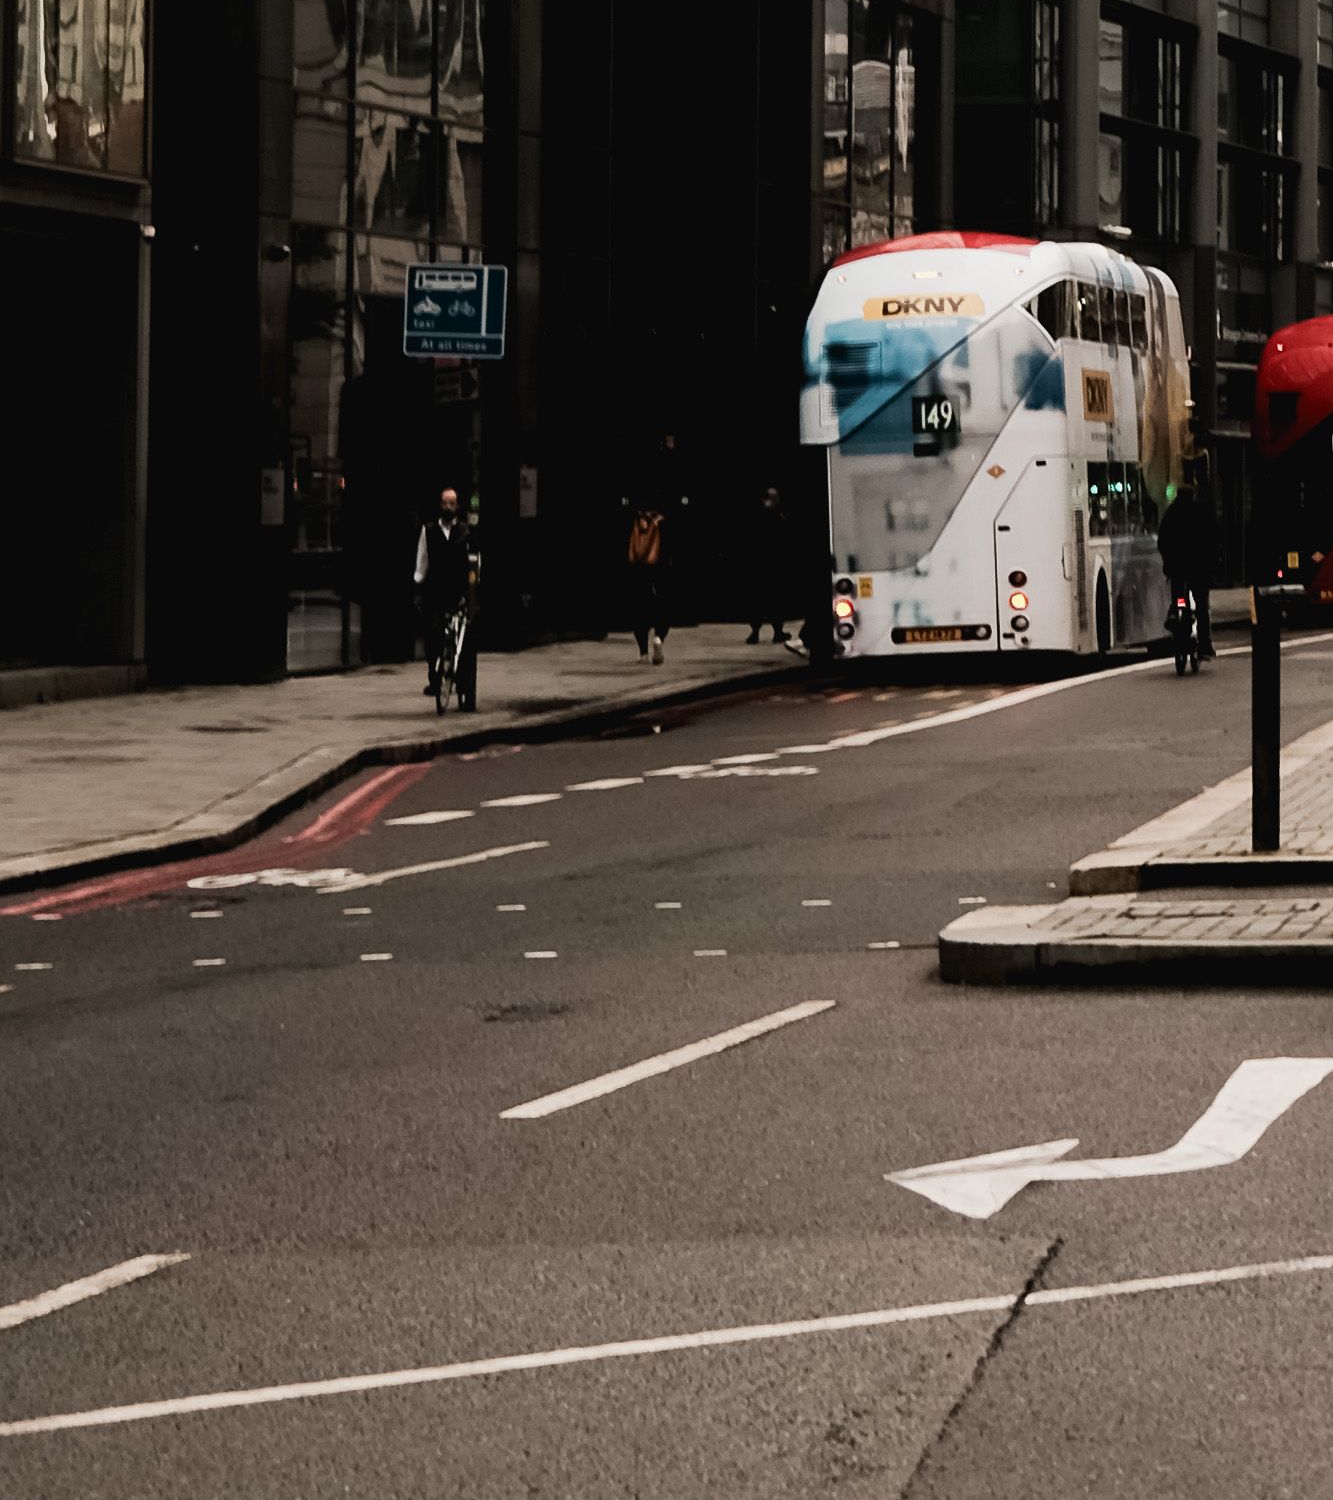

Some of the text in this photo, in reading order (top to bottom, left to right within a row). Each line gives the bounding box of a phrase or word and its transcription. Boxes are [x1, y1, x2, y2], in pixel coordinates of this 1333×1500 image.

[882, 297, 965, 317] DKNY
[421, 339, 487, 352] At all times
[920, 400, 952, 431] 149
